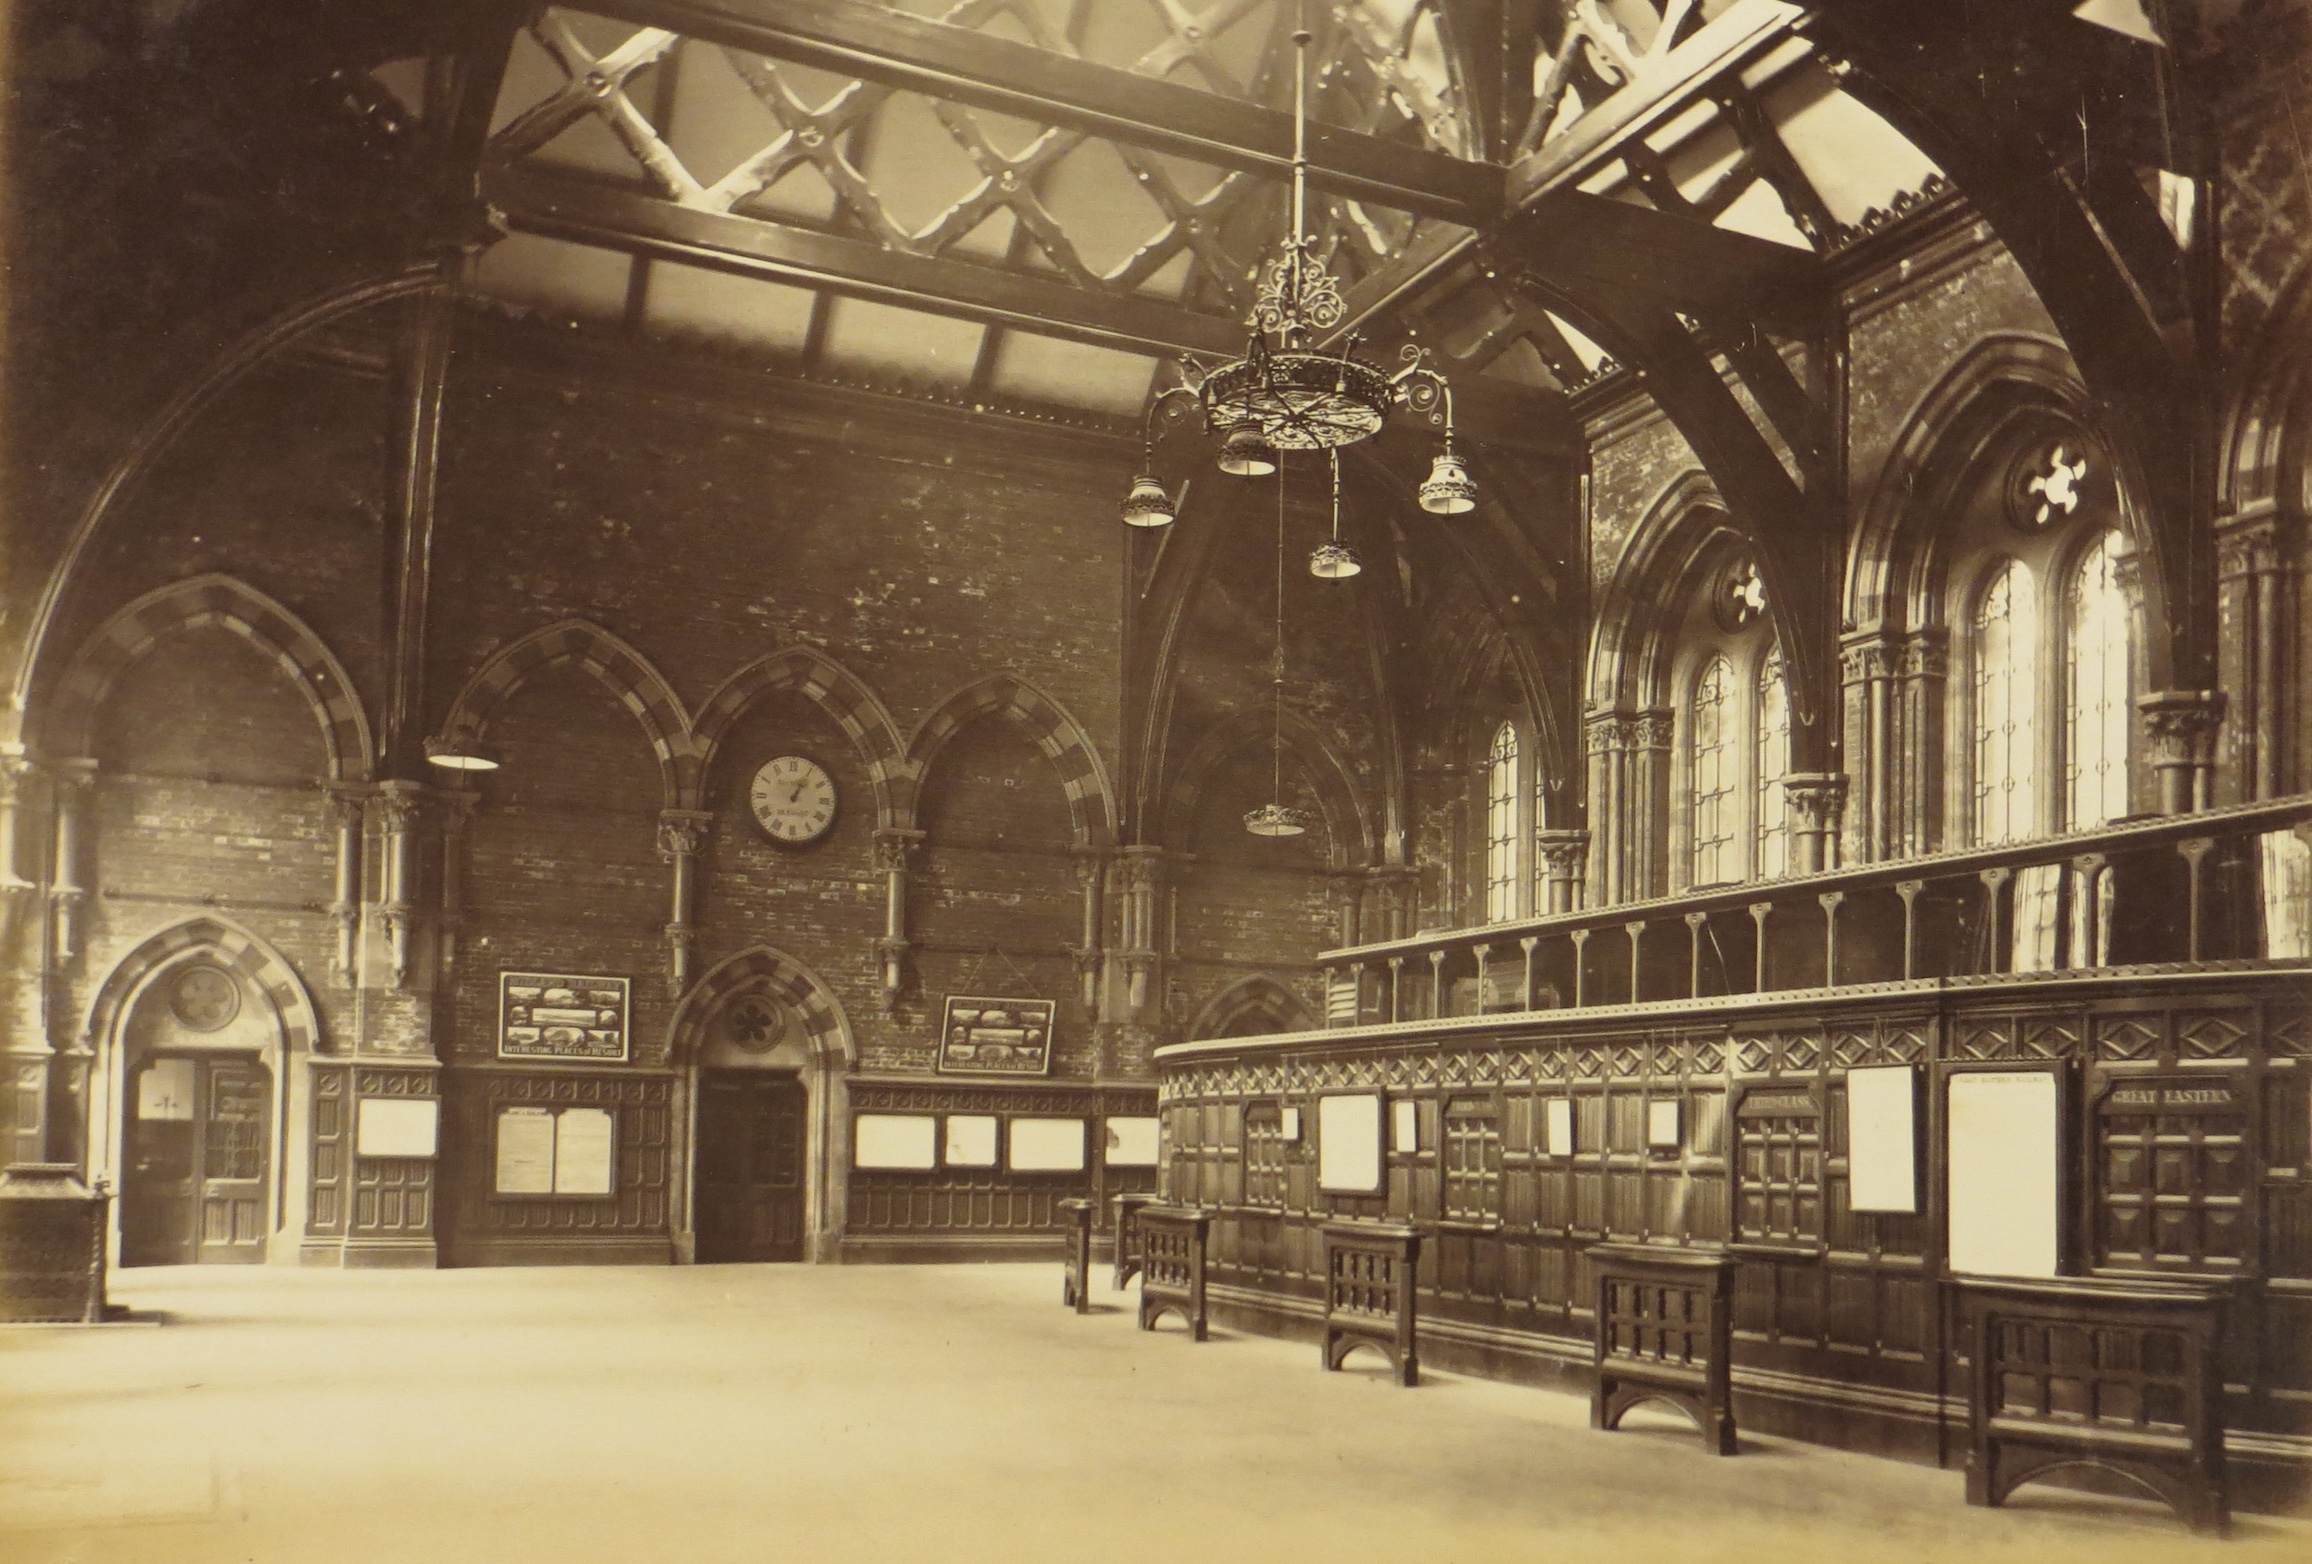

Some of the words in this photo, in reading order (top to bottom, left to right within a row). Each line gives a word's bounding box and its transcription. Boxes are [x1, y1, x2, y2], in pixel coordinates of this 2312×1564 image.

[504, 1045, 552, 1054] INTERESTING
[554, 1046, 582, 1055] PLACES
[592, 1048, 621, 1056] RESORT
[2112, 1089, 2158, 1103] GREAT
[2164, 1089, 2232, 1103] EASTERN
